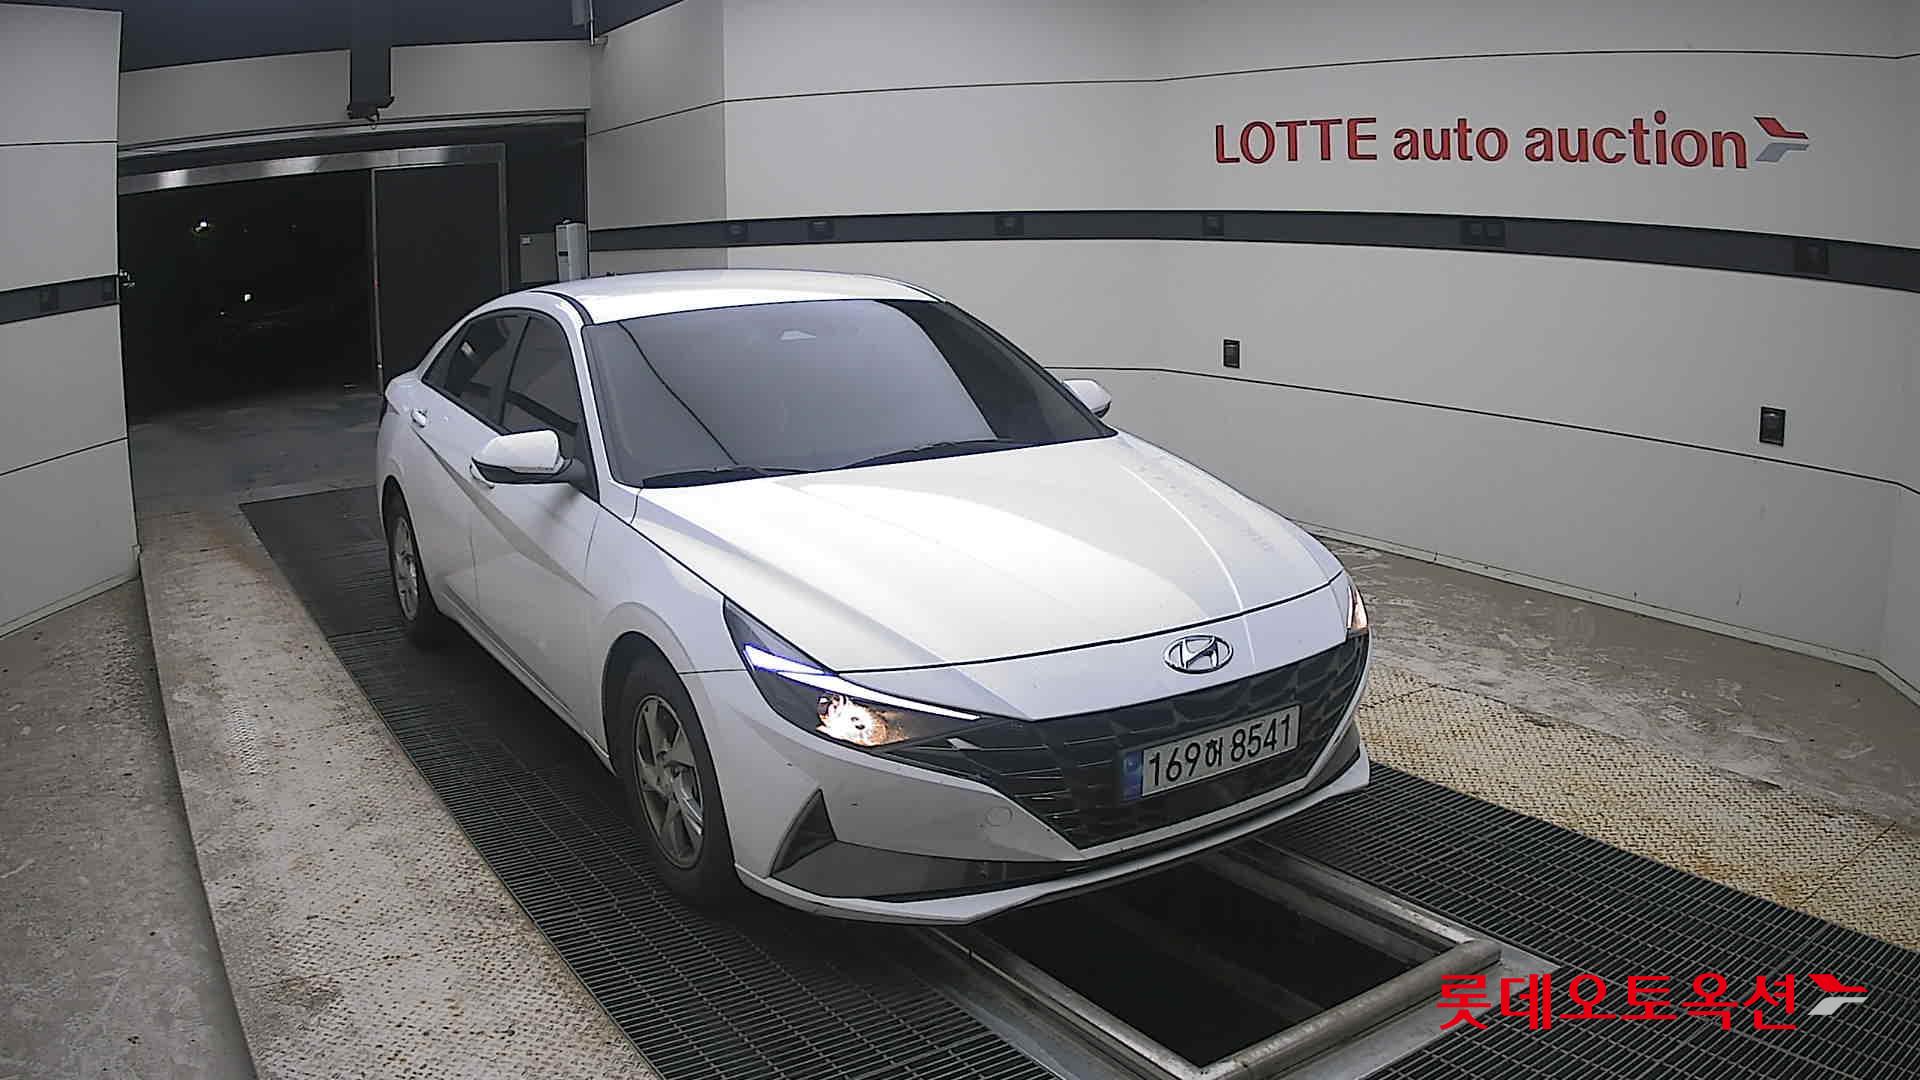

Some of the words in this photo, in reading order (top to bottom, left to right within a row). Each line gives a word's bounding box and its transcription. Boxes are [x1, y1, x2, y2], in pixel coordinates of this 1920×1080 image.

[1215, 117, 1377, 164] LOTTE
[1393, 117, 1508, 161] auto
[1525, 109, 1748, 169] auction
[1230, 713, 1291, 763] 8541
